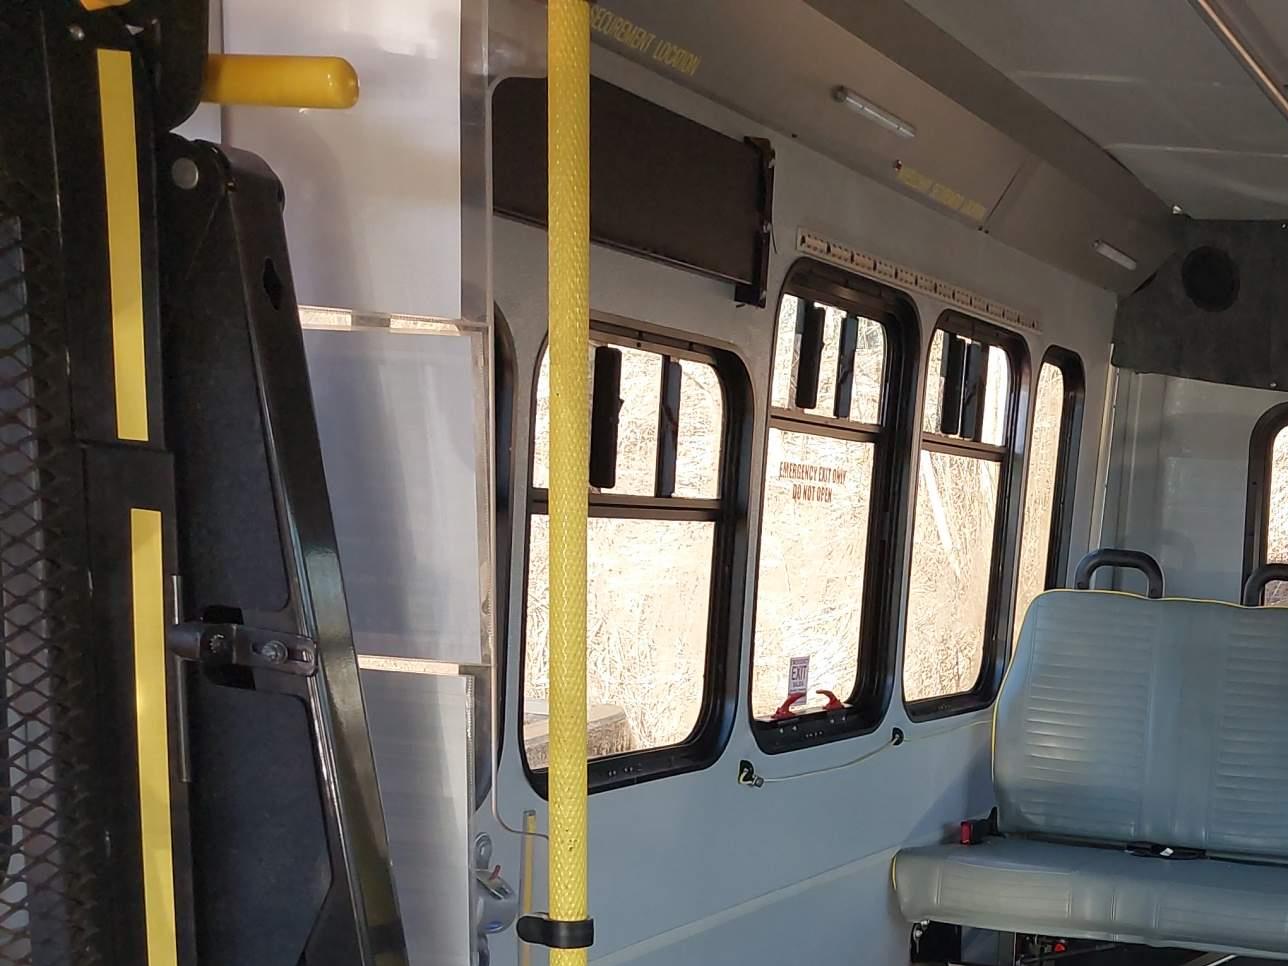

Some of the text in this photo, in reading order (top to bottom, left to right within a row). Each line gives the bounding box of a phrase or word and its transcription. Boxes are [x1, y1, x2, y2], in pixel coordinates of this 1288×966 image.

[779, 461, 817, 481] EMERGENCY
[818, 466, 832, 482] EXIT
[792, 483, 832, 502] DO NOT OPEN
[791, 665, 807, 680] EXIT
